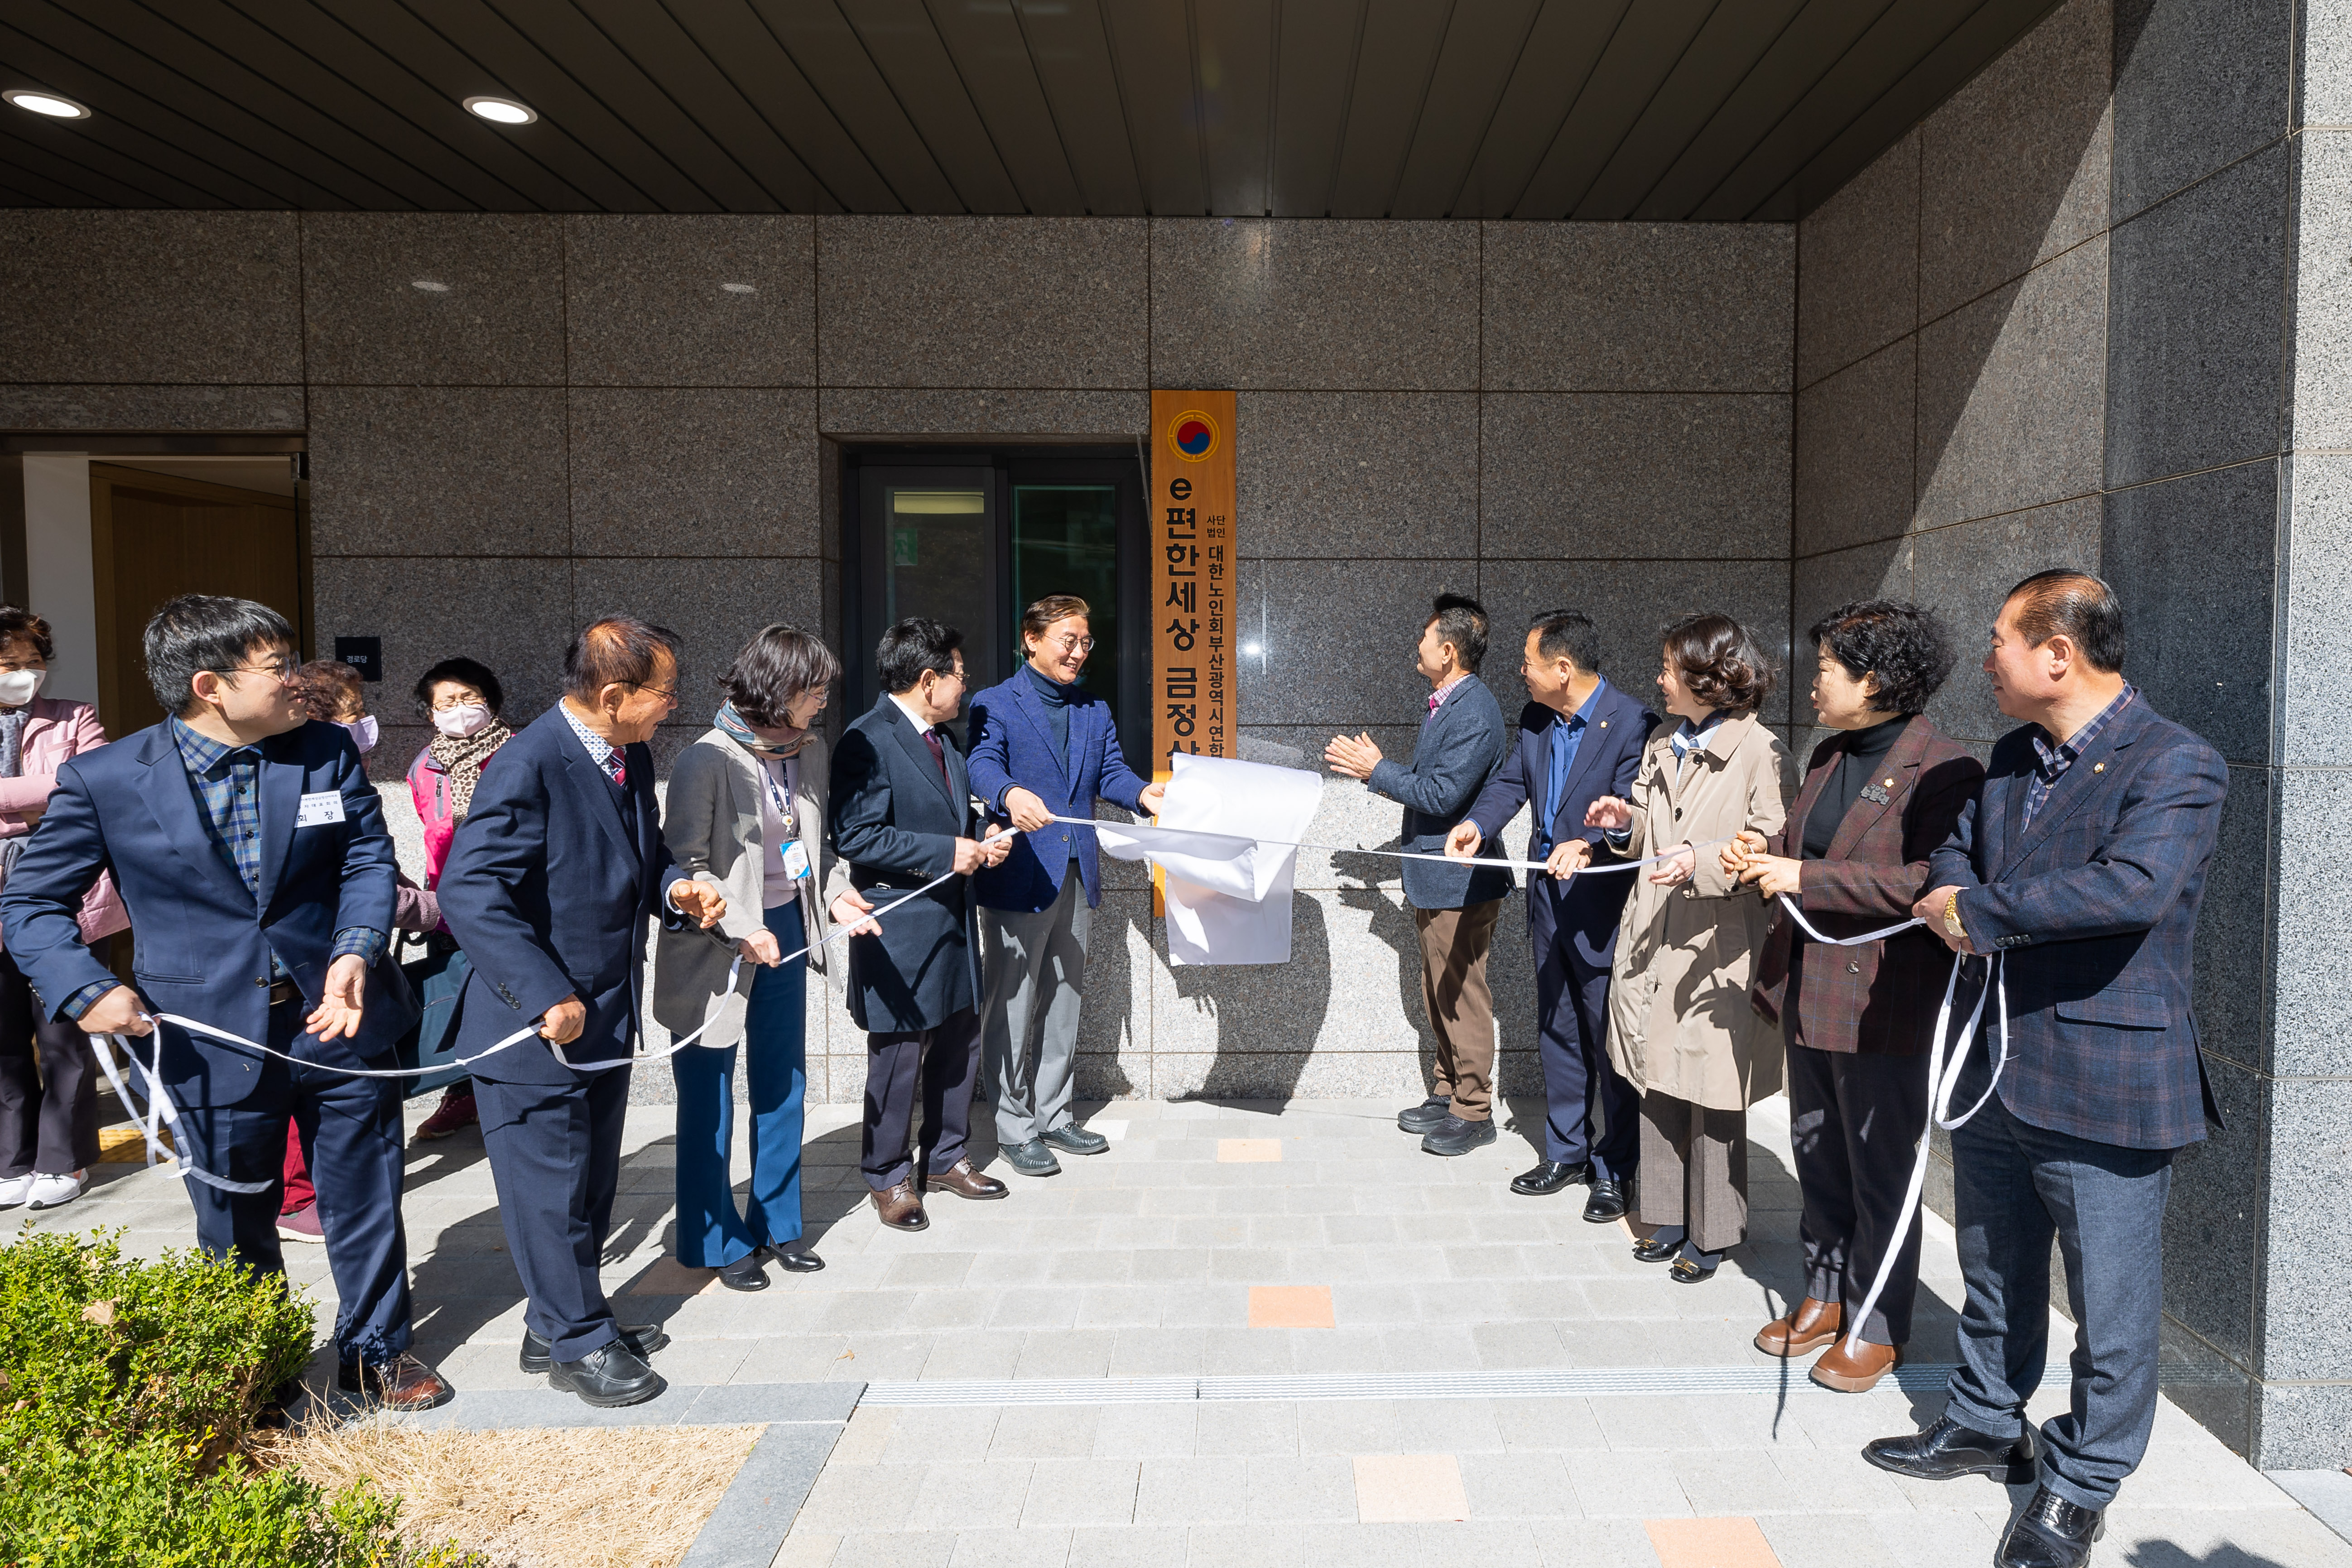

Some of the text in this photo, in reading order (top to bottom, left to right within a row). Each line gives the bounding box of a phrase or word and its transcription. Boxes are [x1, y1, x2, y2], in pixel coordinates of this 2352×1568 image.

[1207, 515, 1226, 525] 사단
[1207, 528, 1225, 538] 법인
[1166, 478, 1200, 651] e편한세상
[346, 655, 367, 664] 경로당
